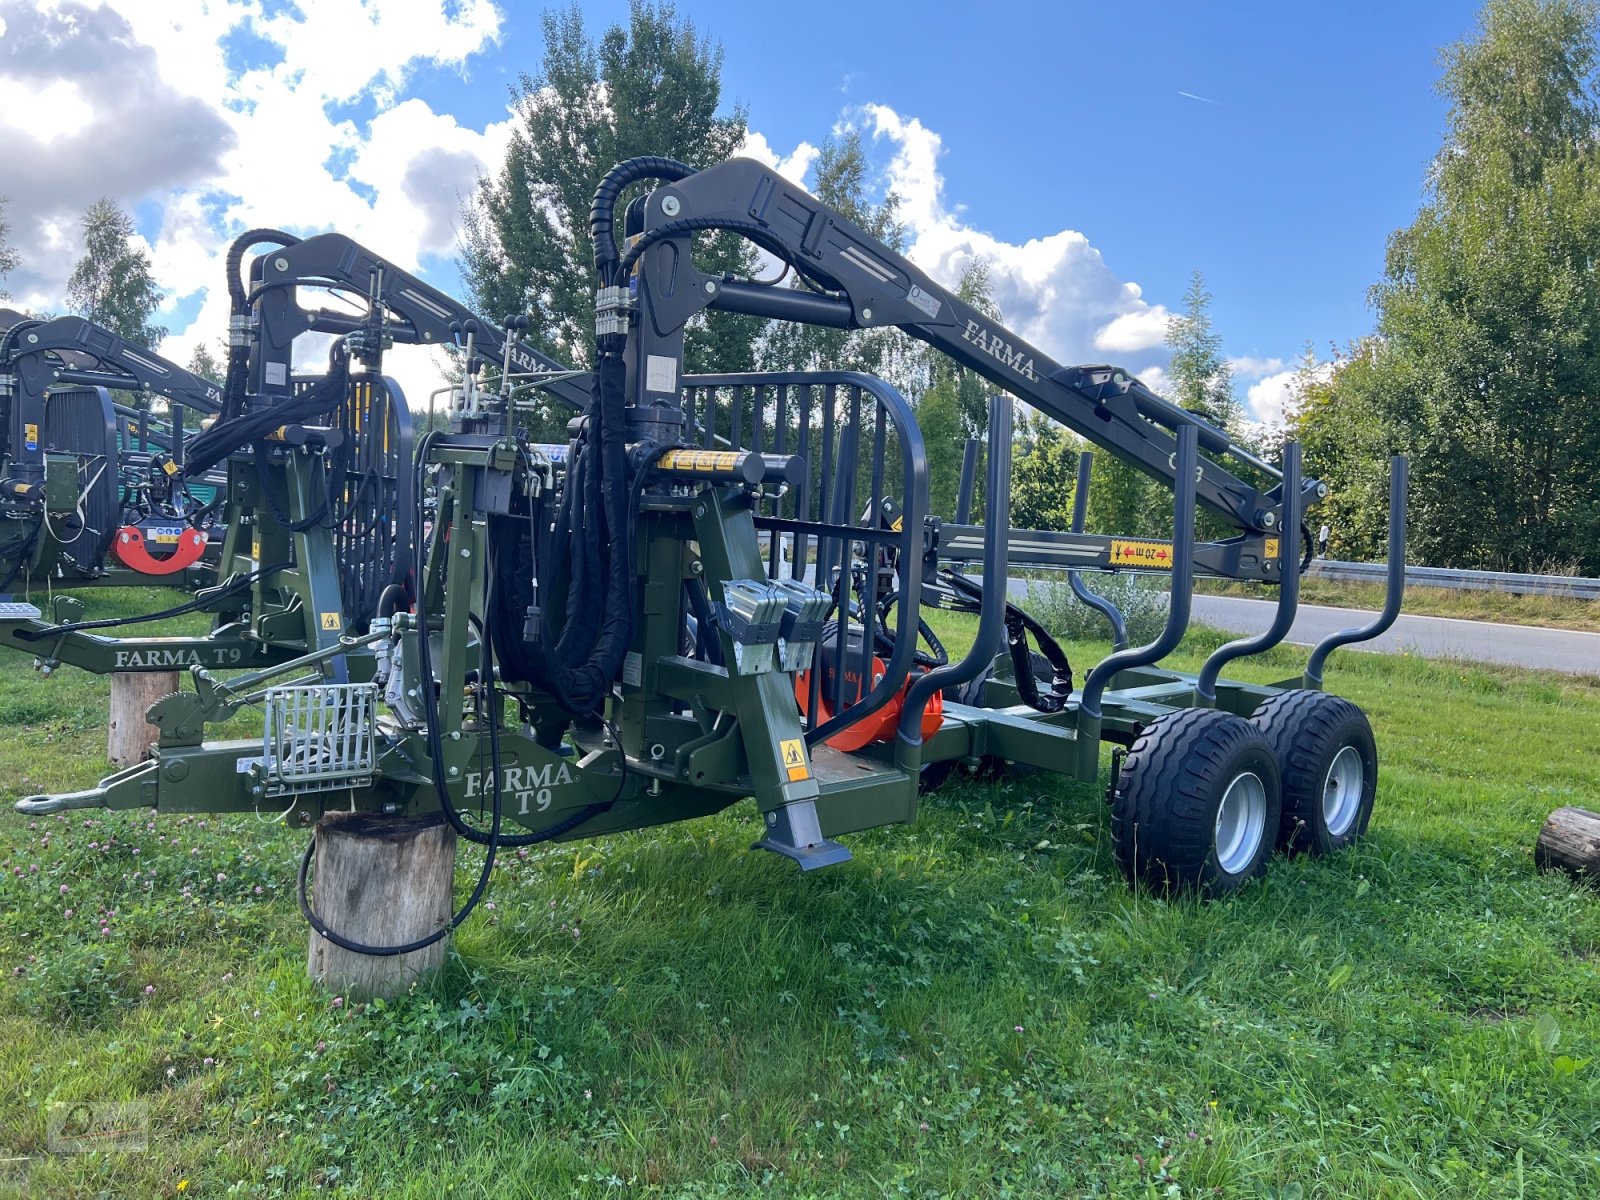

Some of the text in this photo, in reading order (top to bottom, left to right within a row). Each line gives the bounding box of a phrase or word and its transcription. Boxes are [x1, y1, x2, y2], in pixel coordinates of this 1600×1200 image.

[962, 318, 1034, 381] FARMA
[1145, 548, 1156, 560] 20
[114, 648, 242, 667] FARMA T9
[463, 762, 574, 798] FARMA
[515, 788, 552, 815] T9
